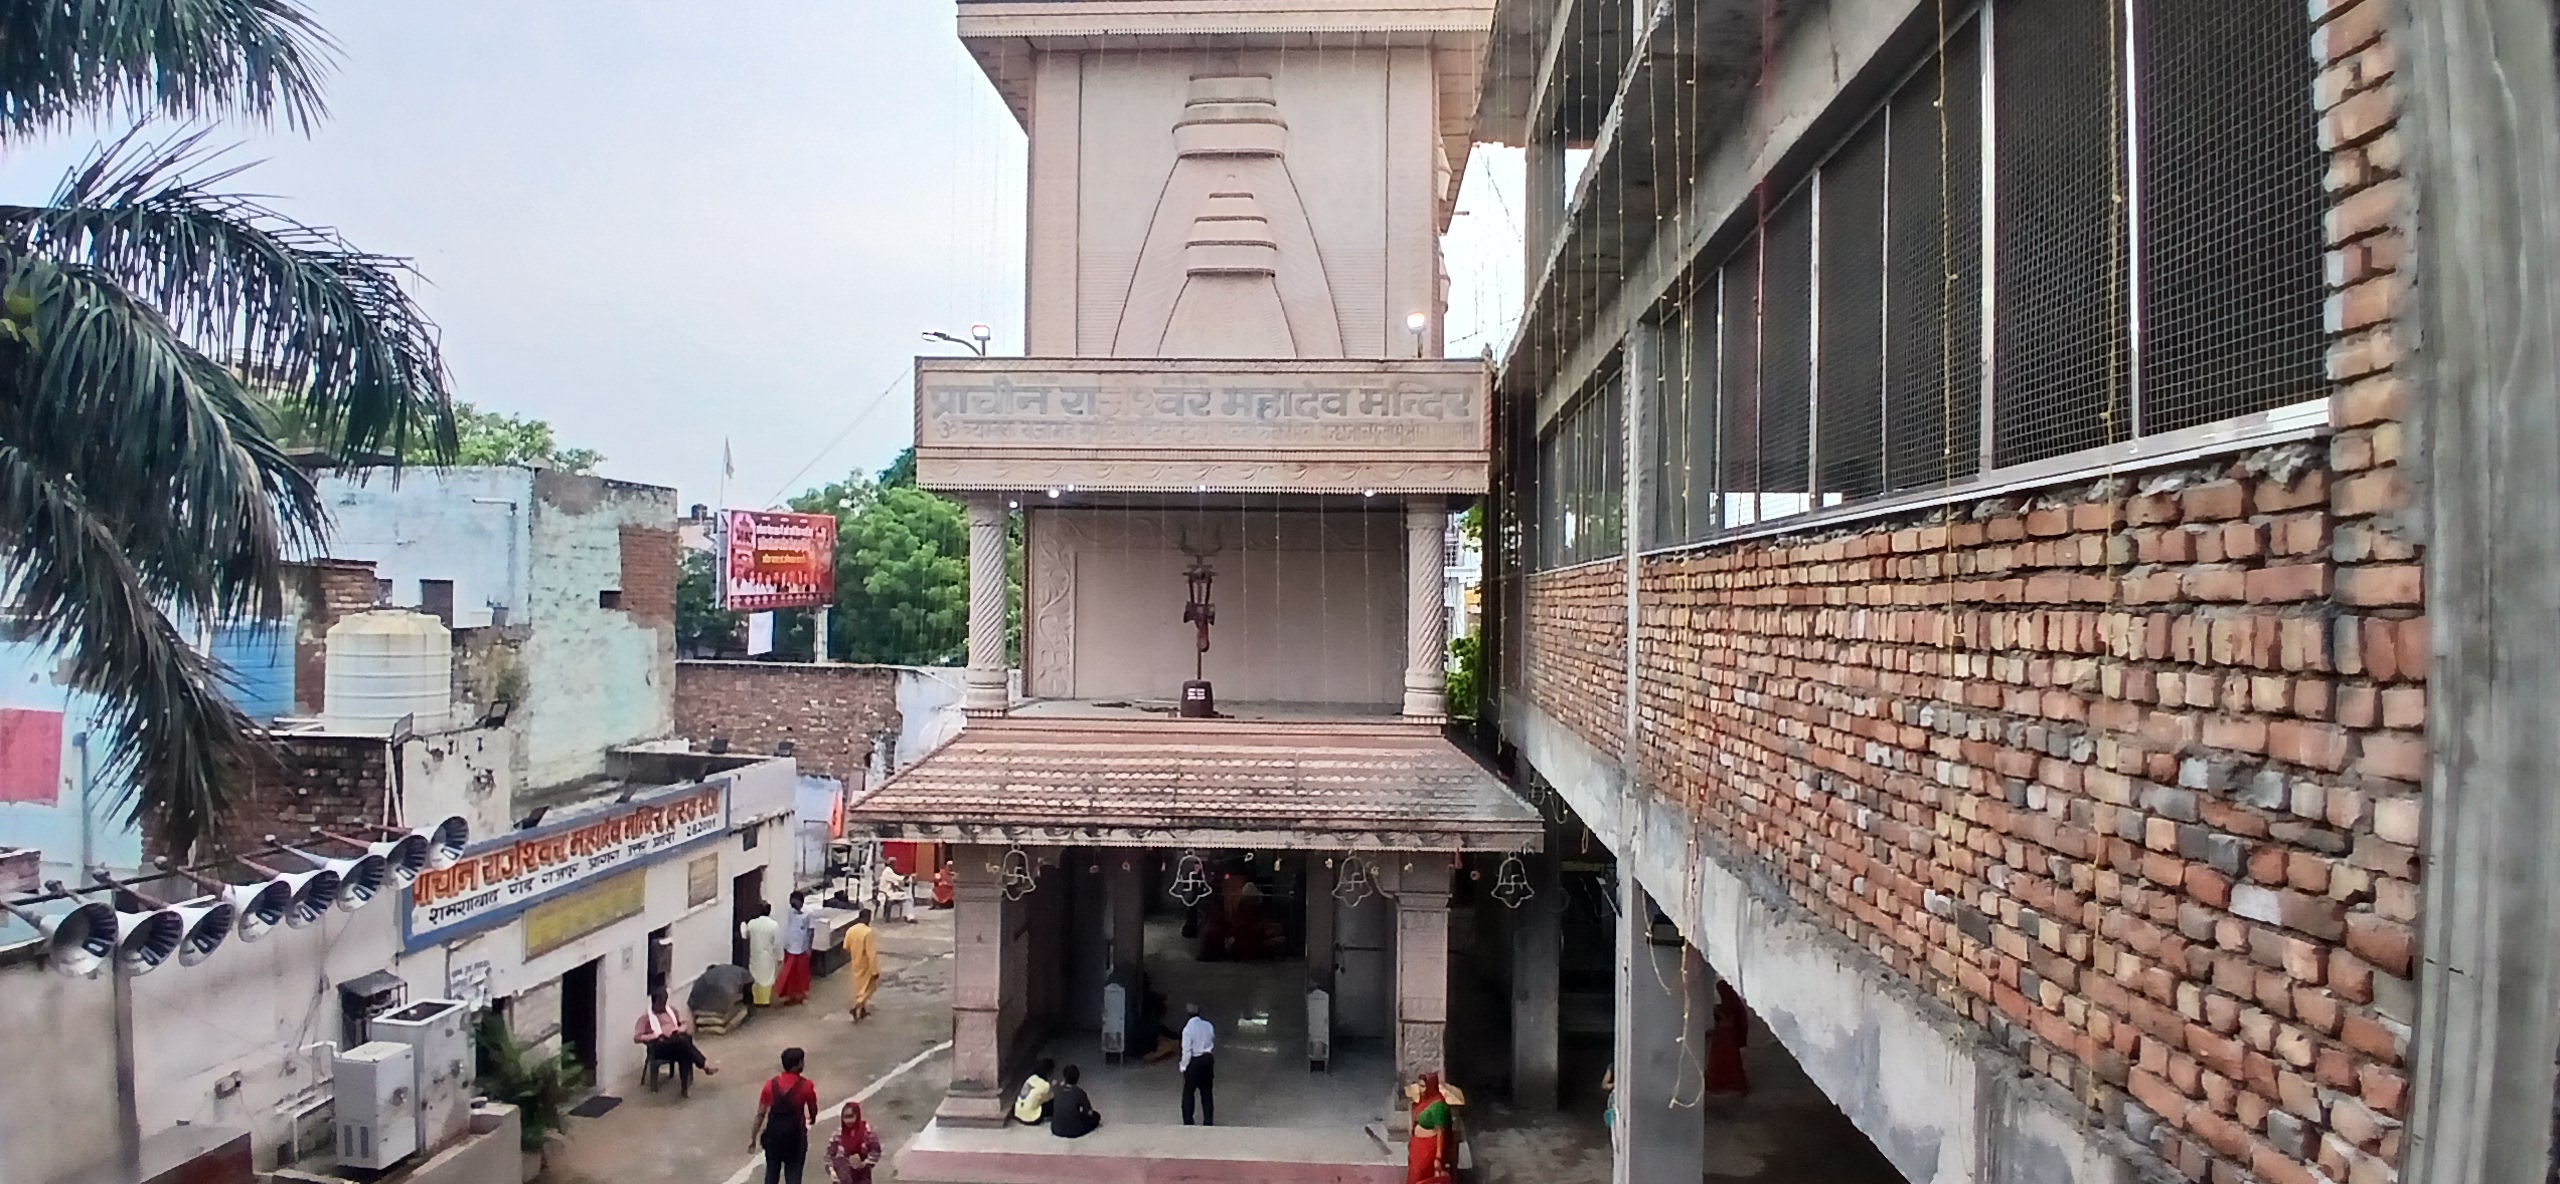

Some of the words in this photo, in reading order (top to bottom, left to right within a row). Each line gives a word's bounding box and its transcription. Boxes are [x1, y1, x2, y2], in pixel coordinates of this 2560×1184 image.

[927, 377, 1051, 419] प्राचीन
[1222, 380, 1351, 420] महादेव
[1358, 379, 1473, 421] मन्दिर
[482, 836, 569, 886] राजेश्वर
